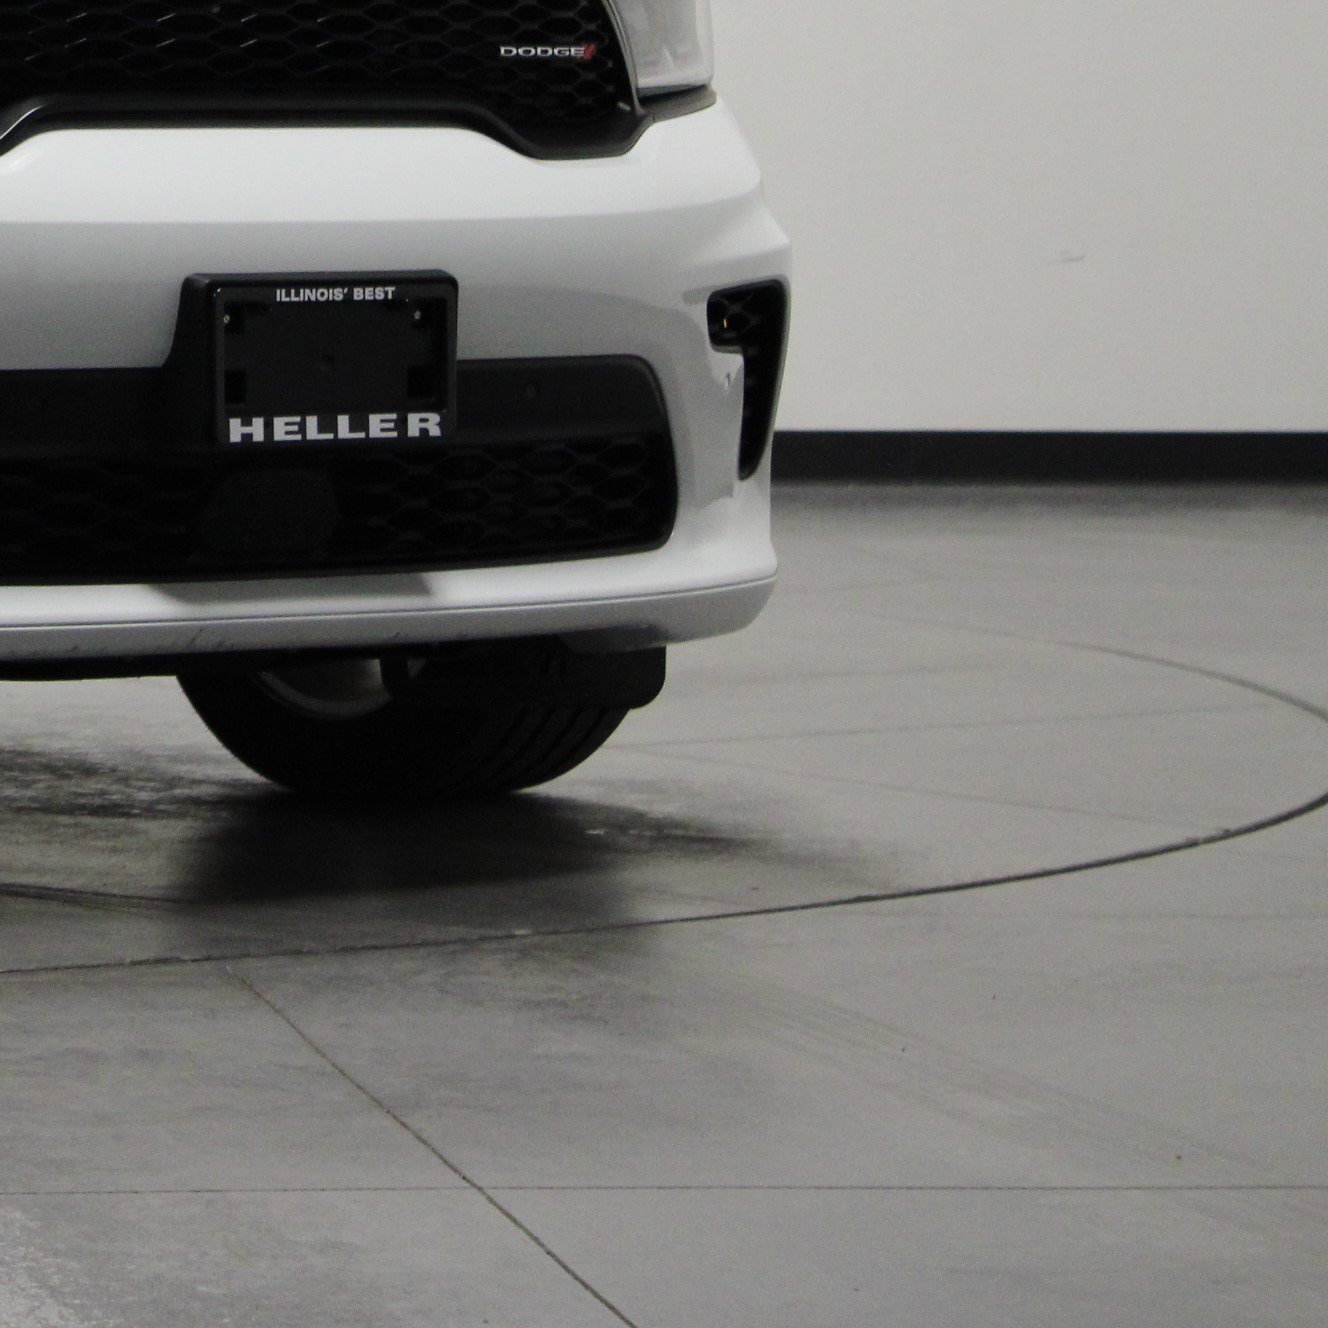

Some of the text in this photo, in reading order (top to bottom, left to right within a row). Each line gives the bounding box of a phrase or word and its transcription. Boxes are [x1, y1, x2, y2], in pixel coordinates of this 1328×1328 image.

[499, 45, 586, 58] DODGE
[352, 286, 395, 301] BEST
[228, 412, 442, 443] HELLER
